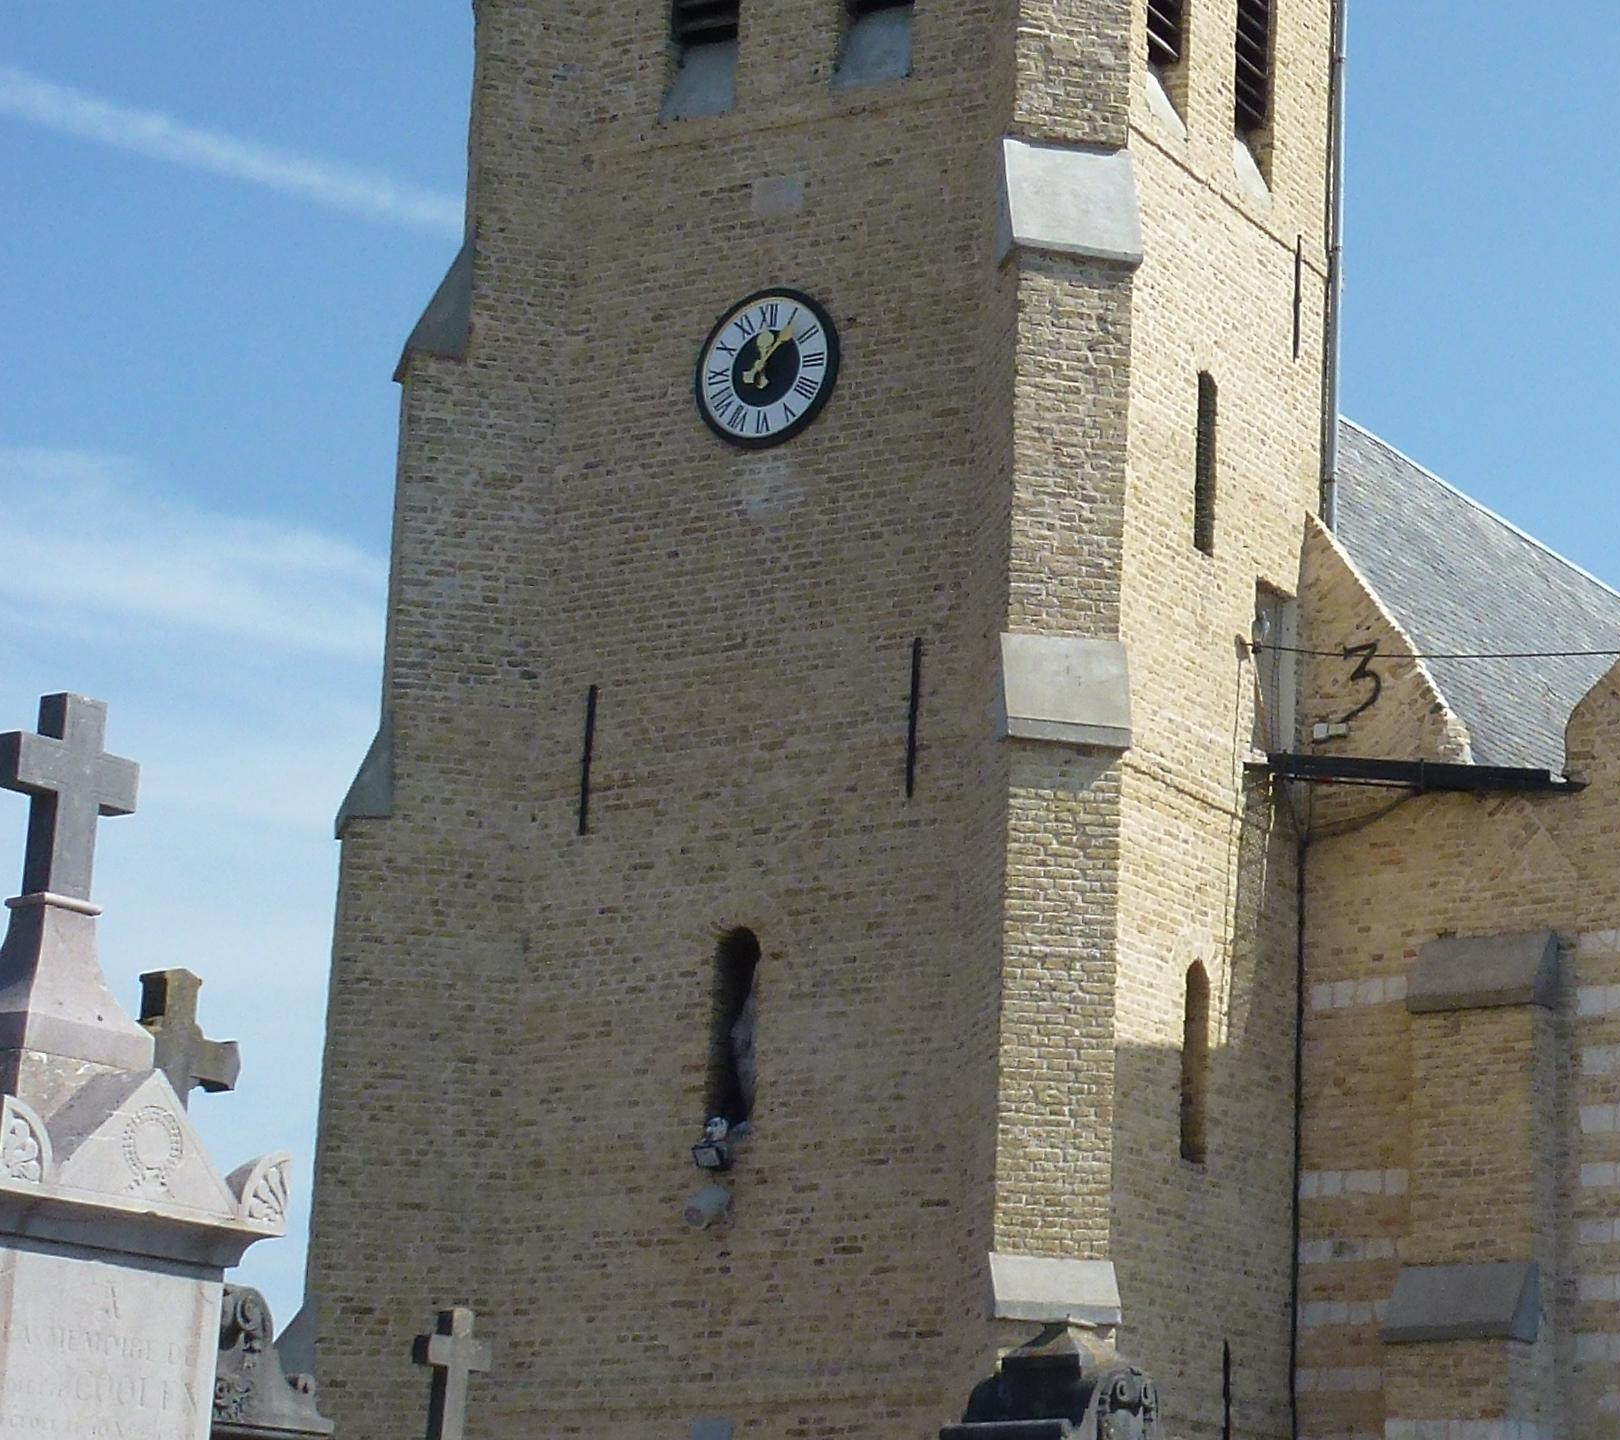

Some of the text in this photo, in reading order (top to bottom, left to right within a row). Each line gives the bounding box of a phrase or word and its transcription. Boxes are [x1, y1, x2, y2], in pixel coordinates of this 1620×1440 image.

[759, 303, 779, 327] XII
[733, 314, 755, 340] XI
[796, 324, 819, 344] II
[715, 340, 737, 357] X
[802, 351, 825, 368] III
[708, 367, 730, 386] IX
[793, 375, 820, 400] IIII
[755, 409, 770, 434] VI
[783, 402, 797, 423] V
